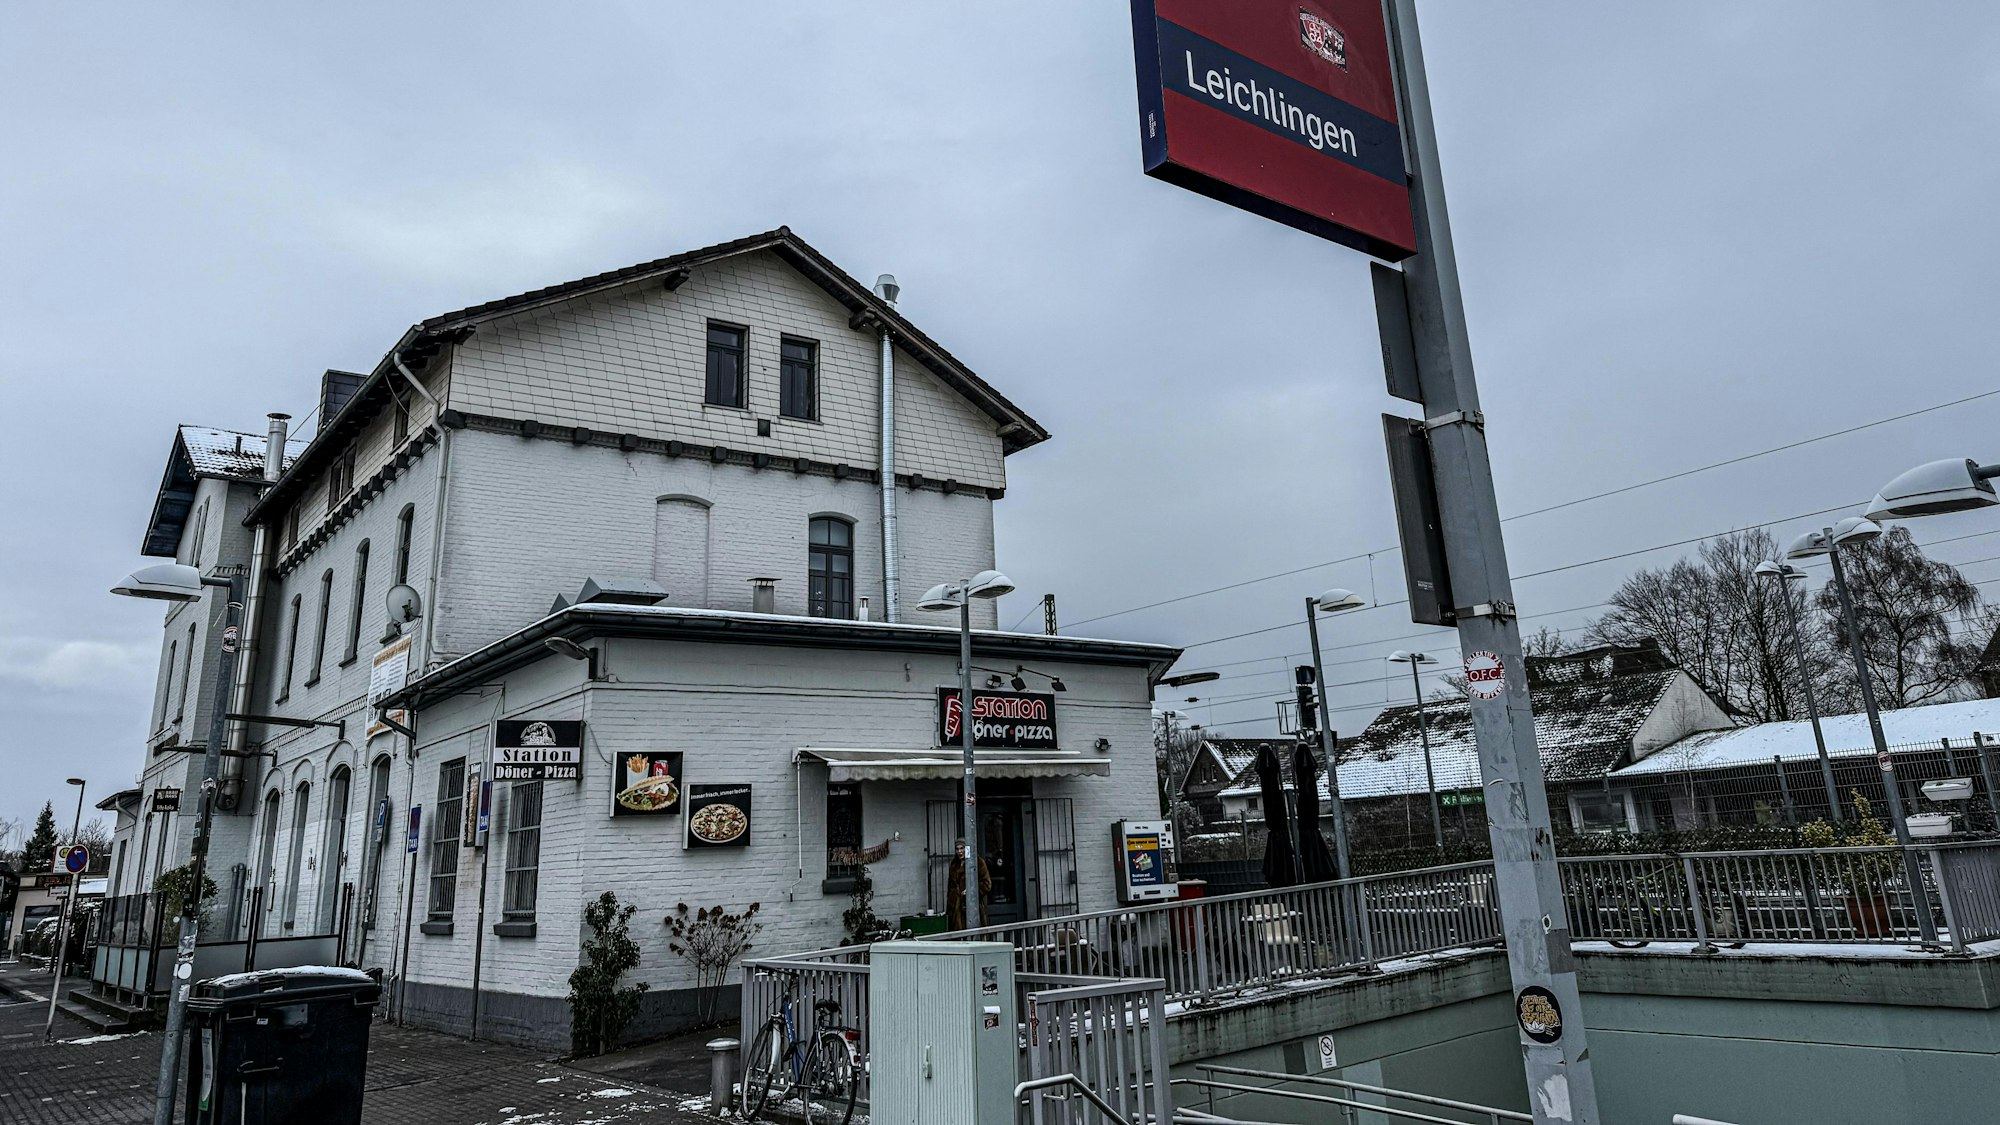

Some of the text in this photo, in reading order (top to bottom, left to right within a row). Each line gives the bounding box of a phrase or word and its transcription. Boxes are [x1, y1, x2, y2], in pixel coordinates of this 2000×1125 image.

[1186, 50, 1358, 158] Leichlingen
[1464, 650, 1494, 668] KOLLEKTIV
[1469, 669, 1500, 681] O.F.C.
[971, 718, 1053, 743] öner pizza
[503, 749, 571, 762] Station
[495, 765, 534, 779] Döner
[544, 765, 577, 779] Pizza
[378, 802, 385, 823] P
